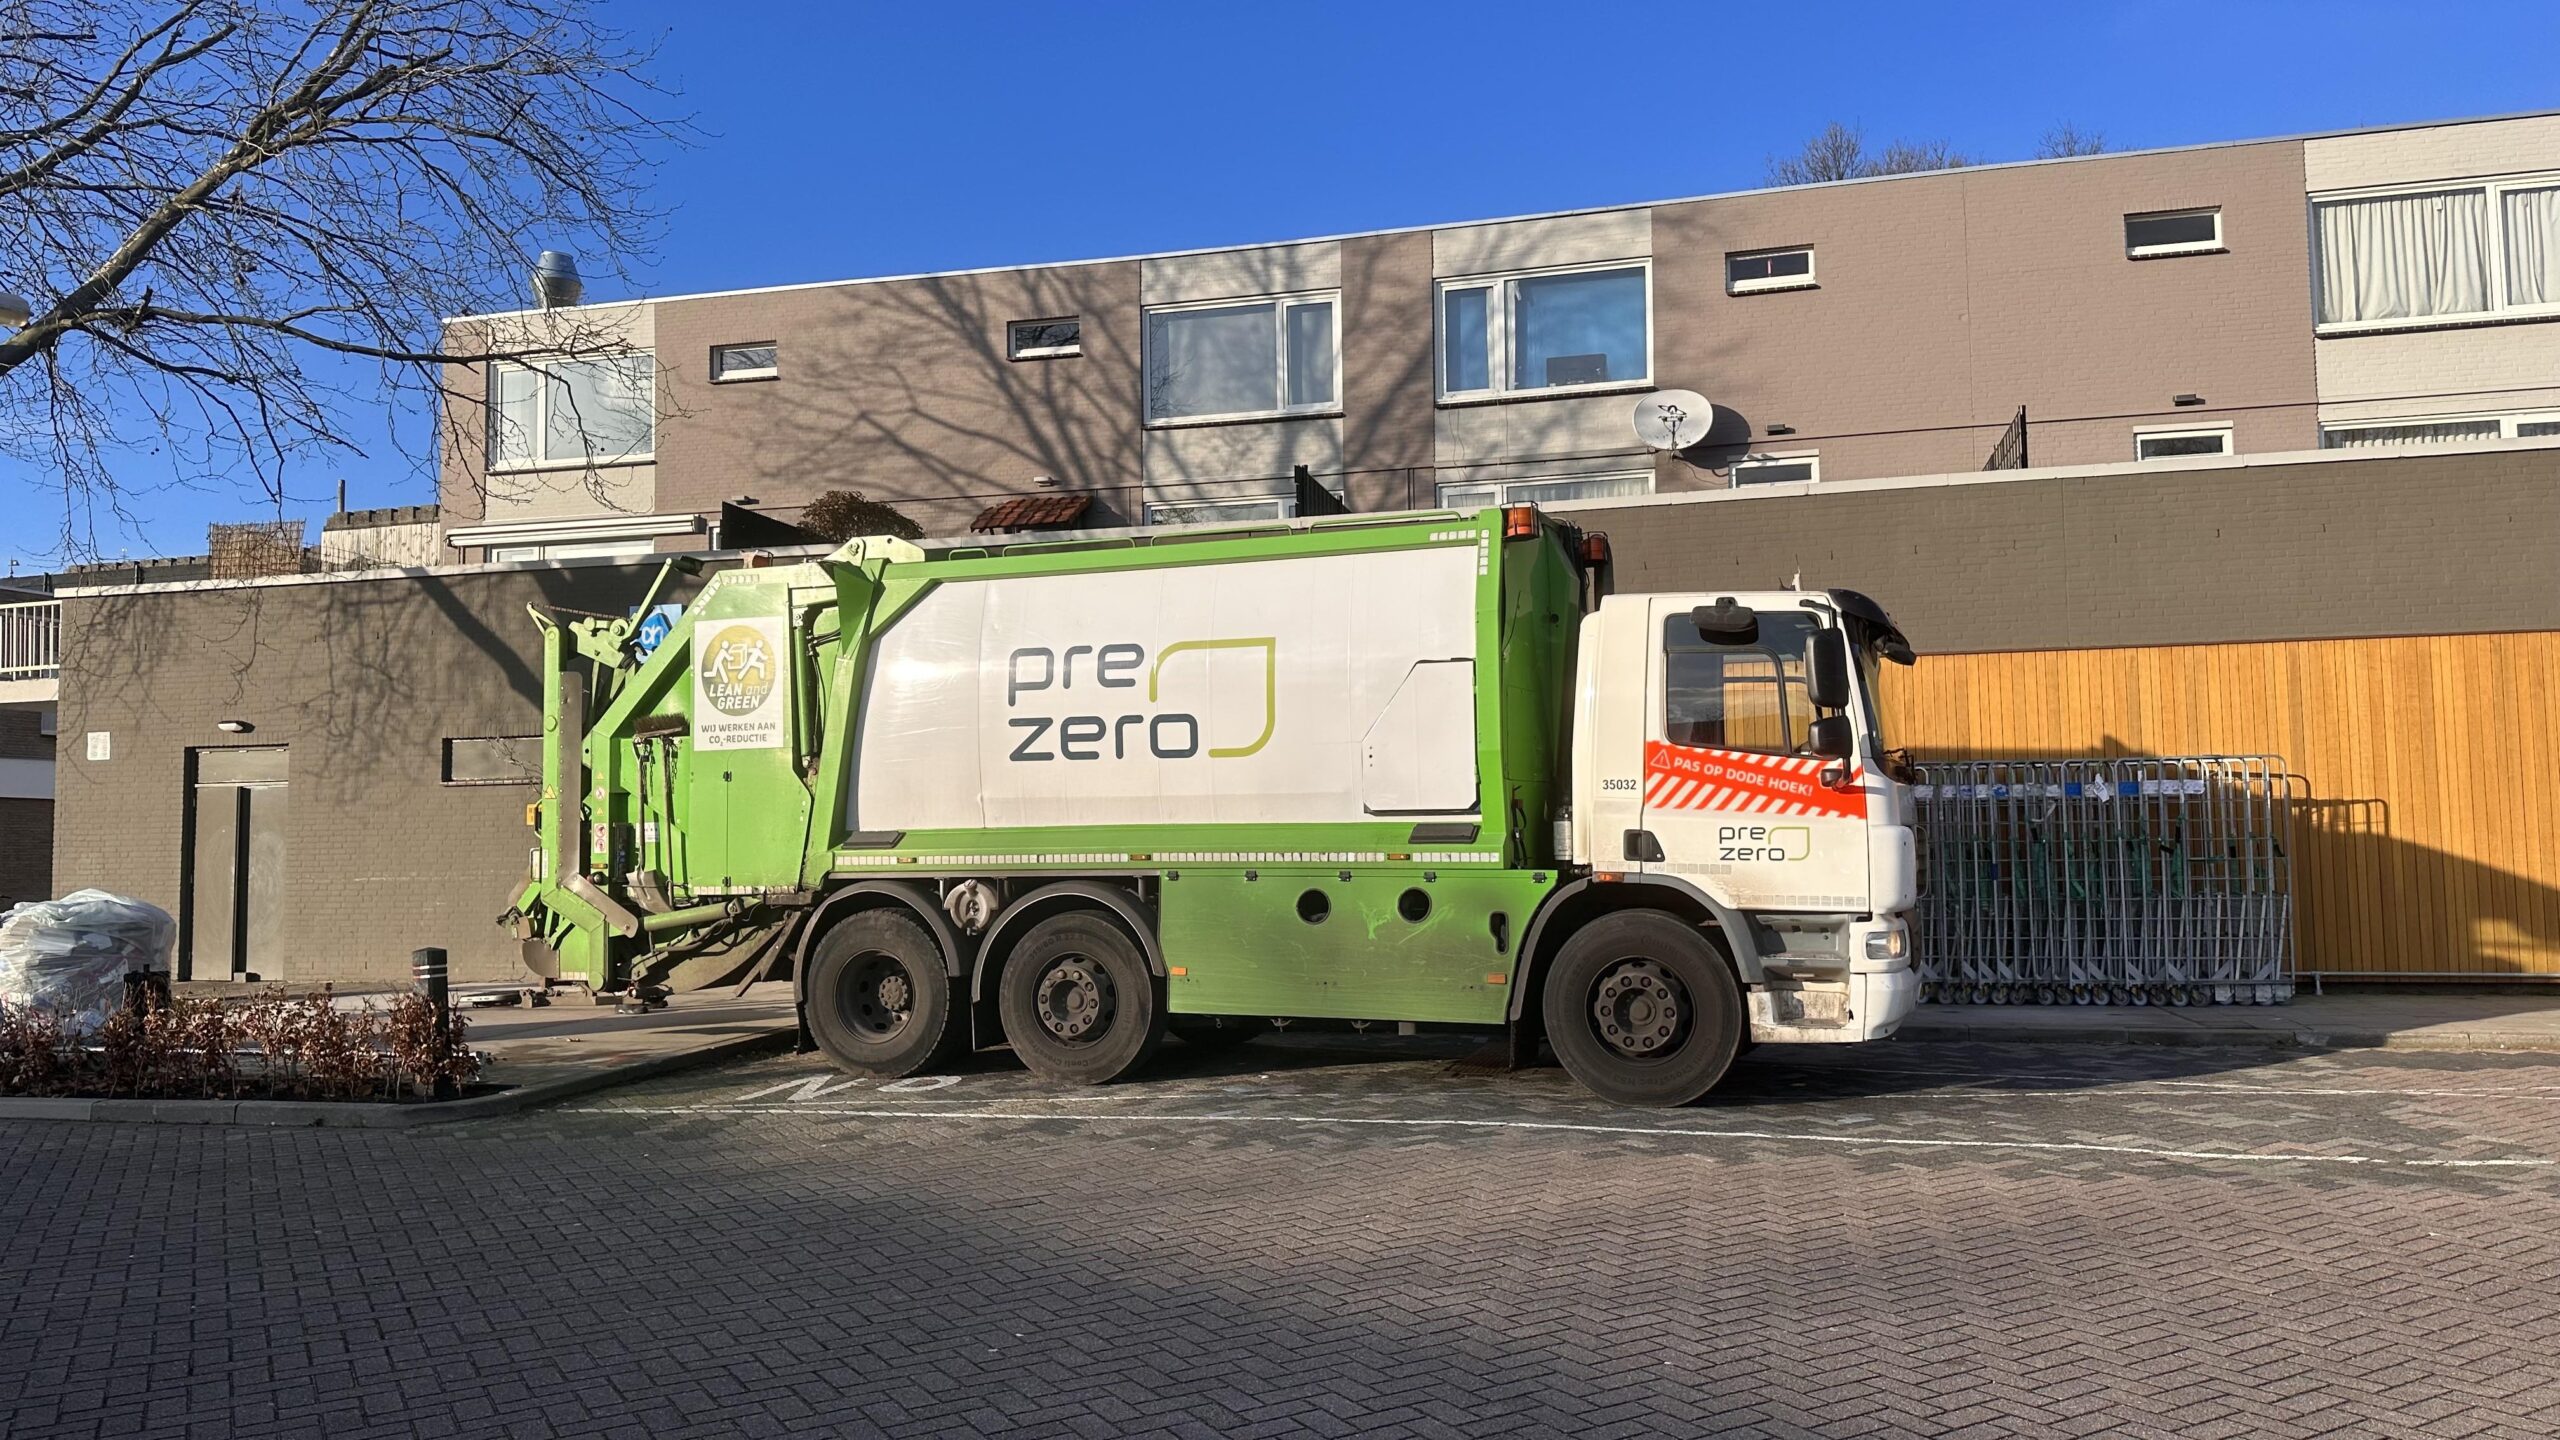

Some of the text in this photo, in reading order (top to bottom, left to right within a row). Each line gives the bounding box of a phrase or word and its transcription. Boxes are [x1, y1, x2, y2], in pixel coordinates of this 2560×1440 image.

[1008, 643, 1145, 706] pre
[709, 681, 768, 697] LEAN and
[717, 695, 760, 709] GREEN
[701, 722, 776, 733] WIJ WERKEN AAN
[1008, 713, 1199, 761] zero
[1602, 779, 1636, 790] 35032
[1674, 756, 1813, 797] PAS OP DODE HOEK!
[1719, 826, 1766, 844] pre
[1719, 847, 1785, 861] zero
